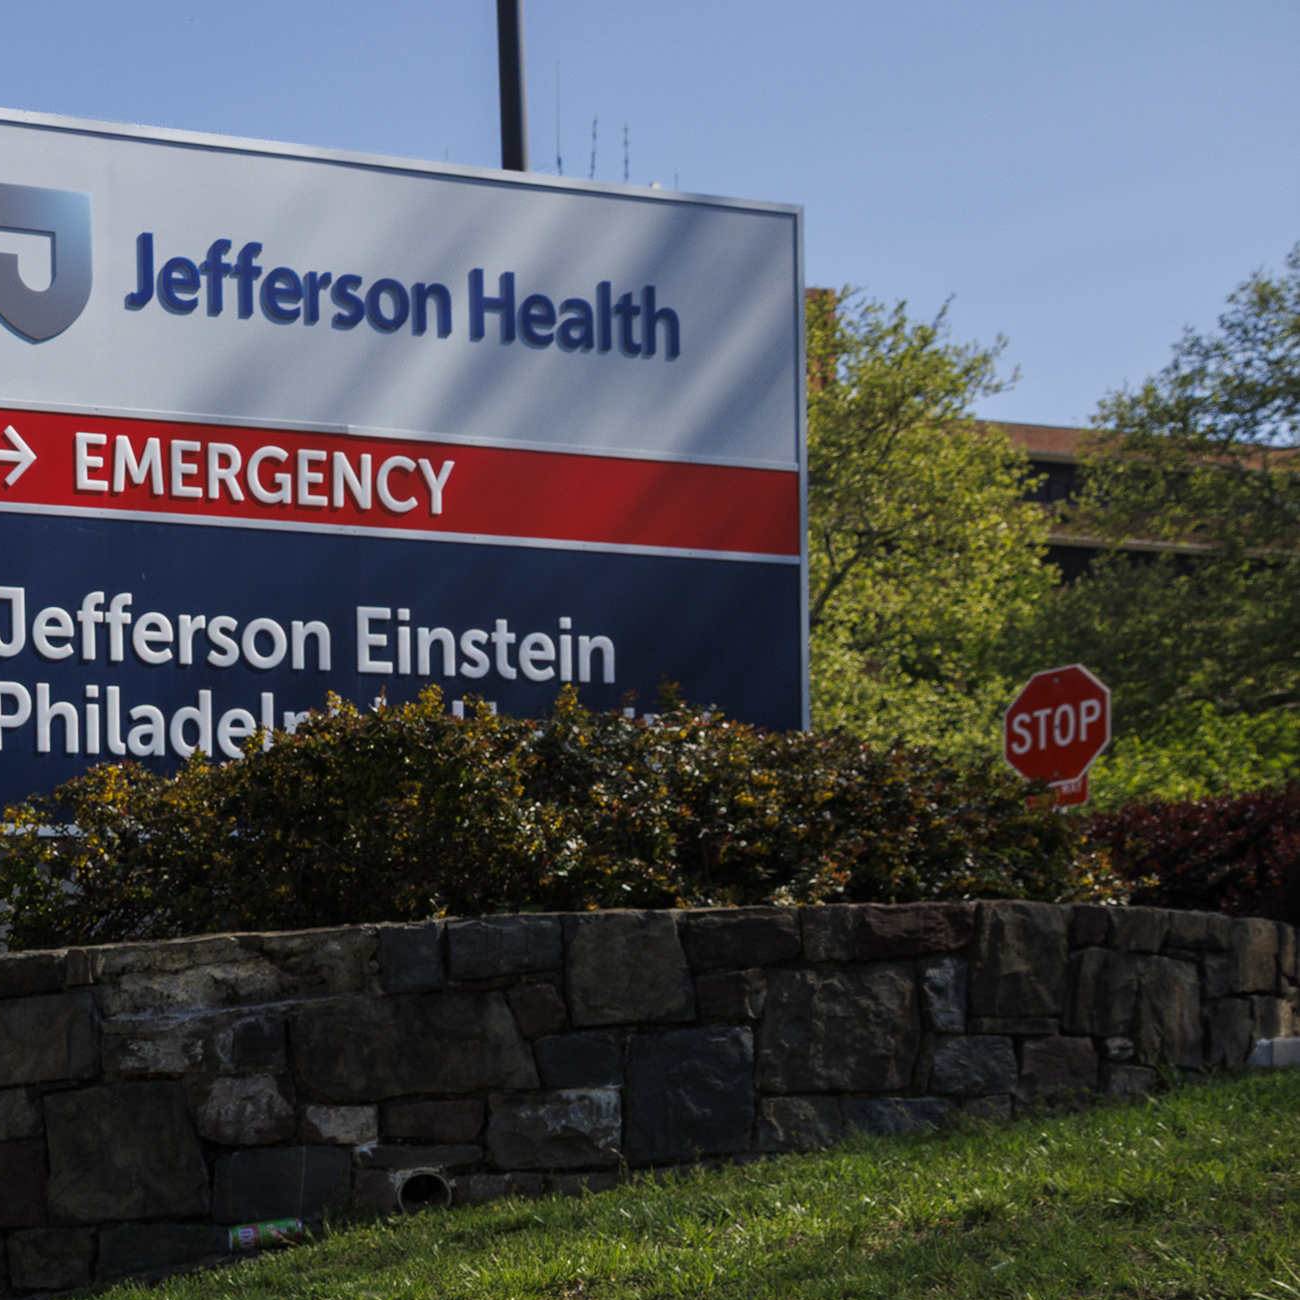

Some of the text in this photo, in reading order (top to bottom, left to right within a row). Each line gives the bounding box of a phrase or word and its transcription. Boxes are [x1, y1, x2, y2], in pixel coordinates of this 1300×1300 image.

[124, 231, 682, 362] Jefferson Health
[72, 430, 455, 516] EMERGENCY
[355, 605, 616, 684] Einstein
[1010, 698, 1102, 755] STOP
